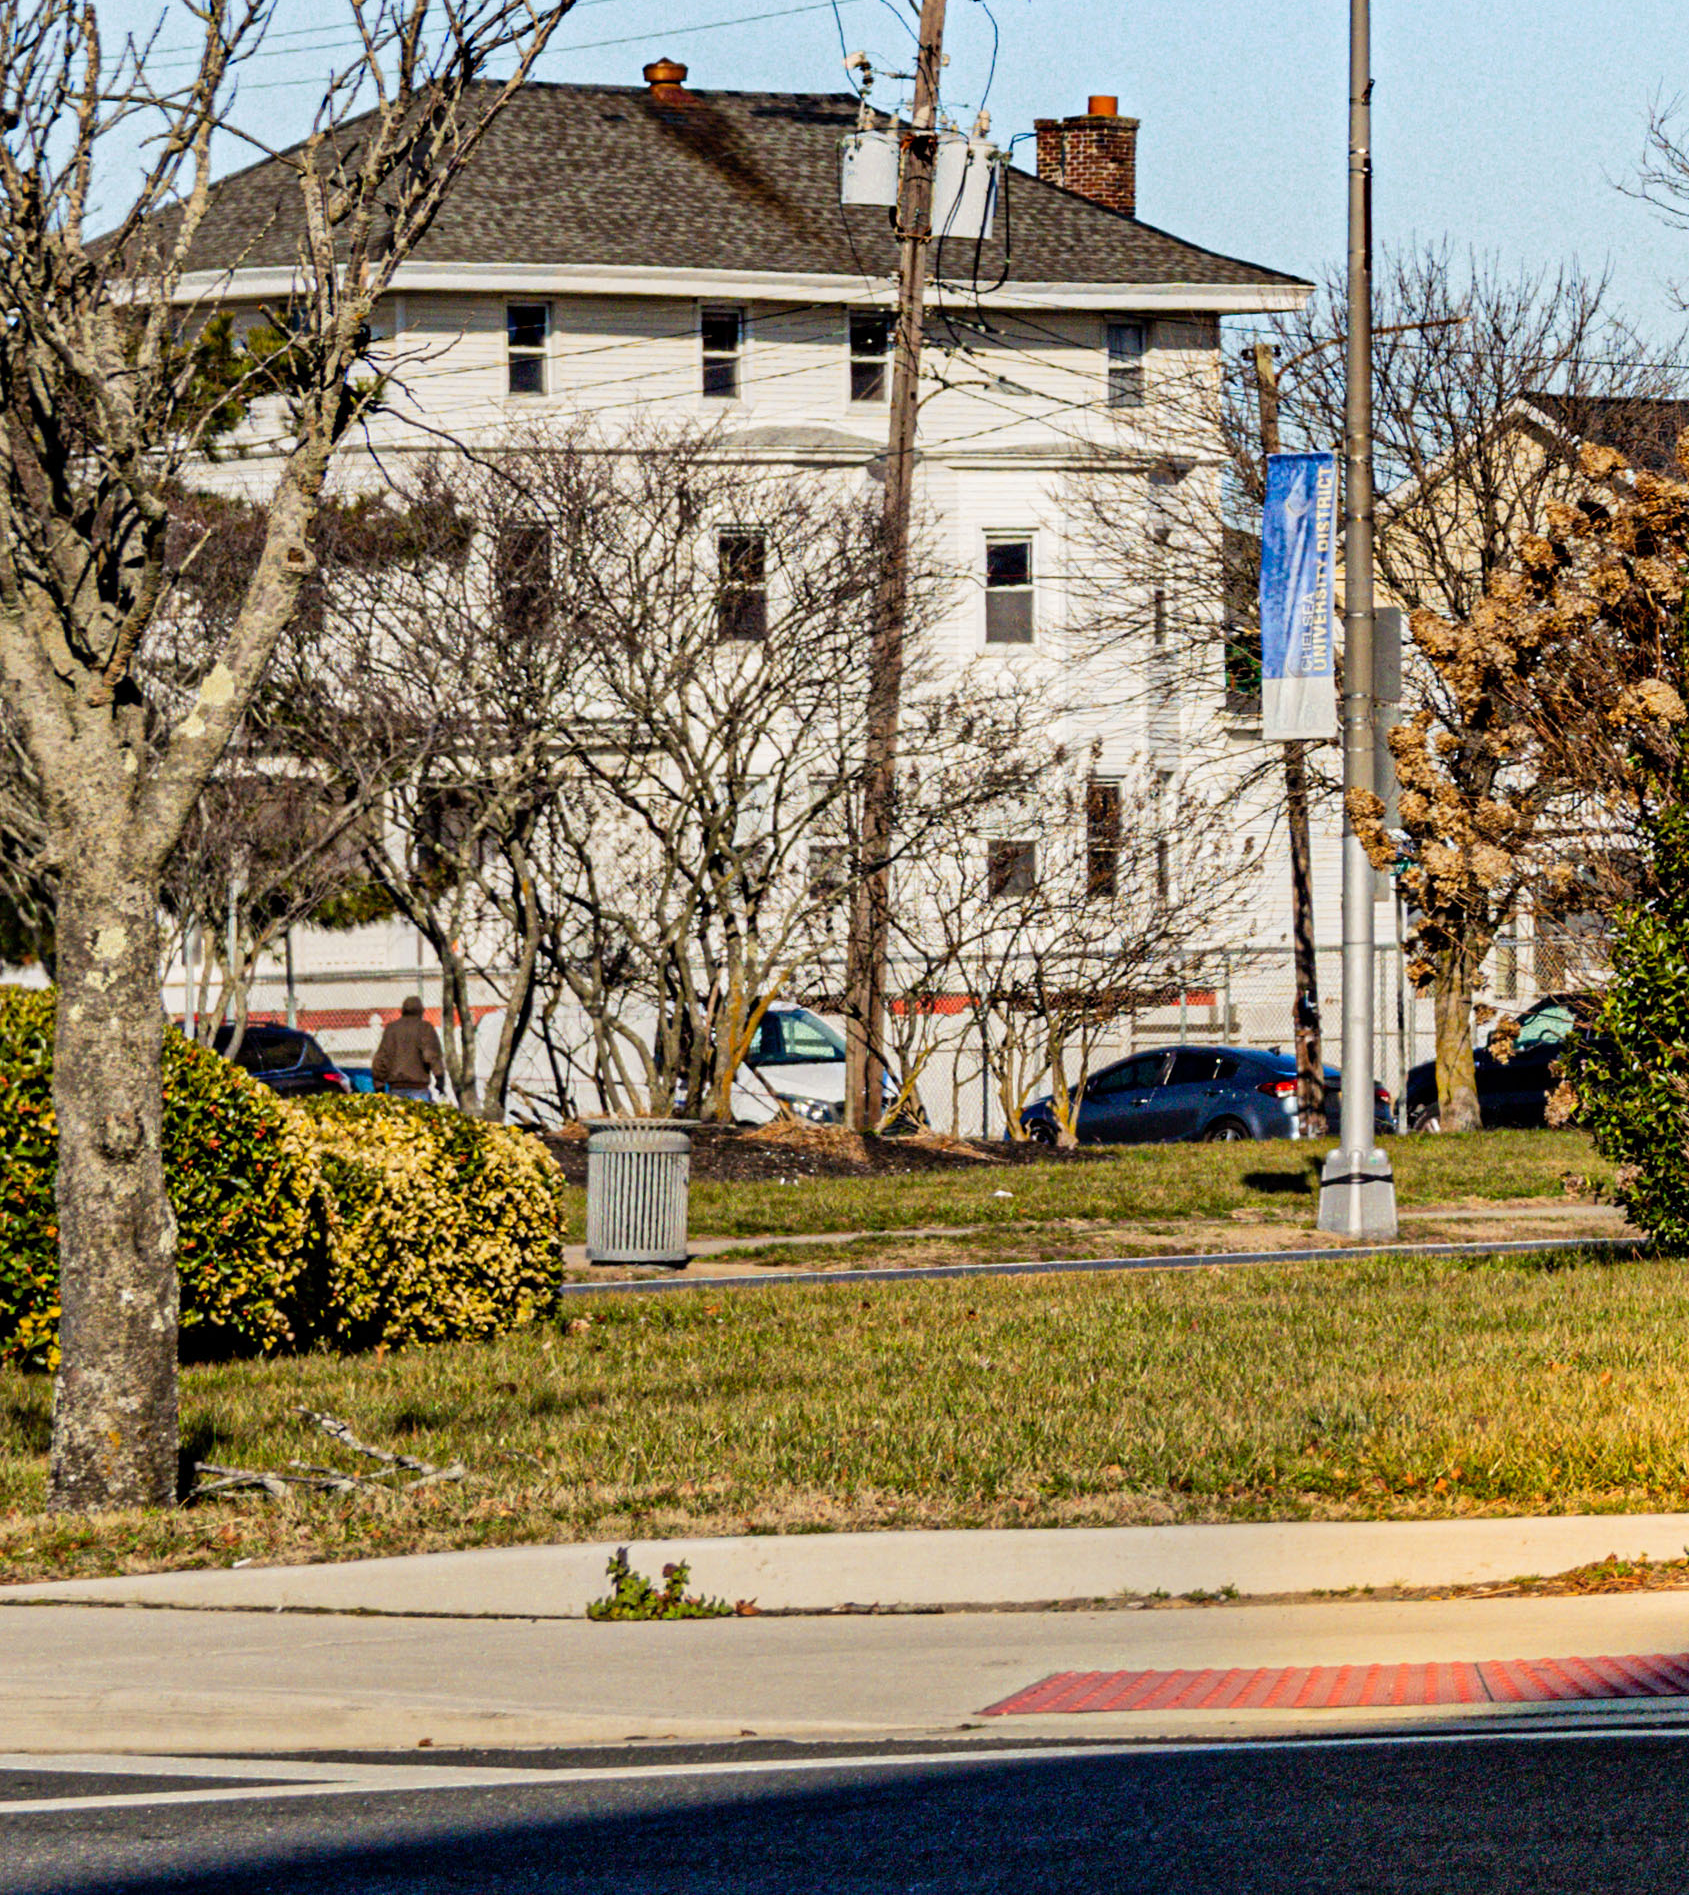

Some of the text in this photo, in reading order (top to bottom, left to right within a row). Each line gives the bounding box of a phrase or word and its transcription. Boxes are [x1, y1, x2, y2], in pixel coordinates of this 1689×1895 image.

[1302, 592, 1315, 673] CHELSEA
[1313, 466, 1333, 672] UNIVERSITY DISTRICT
